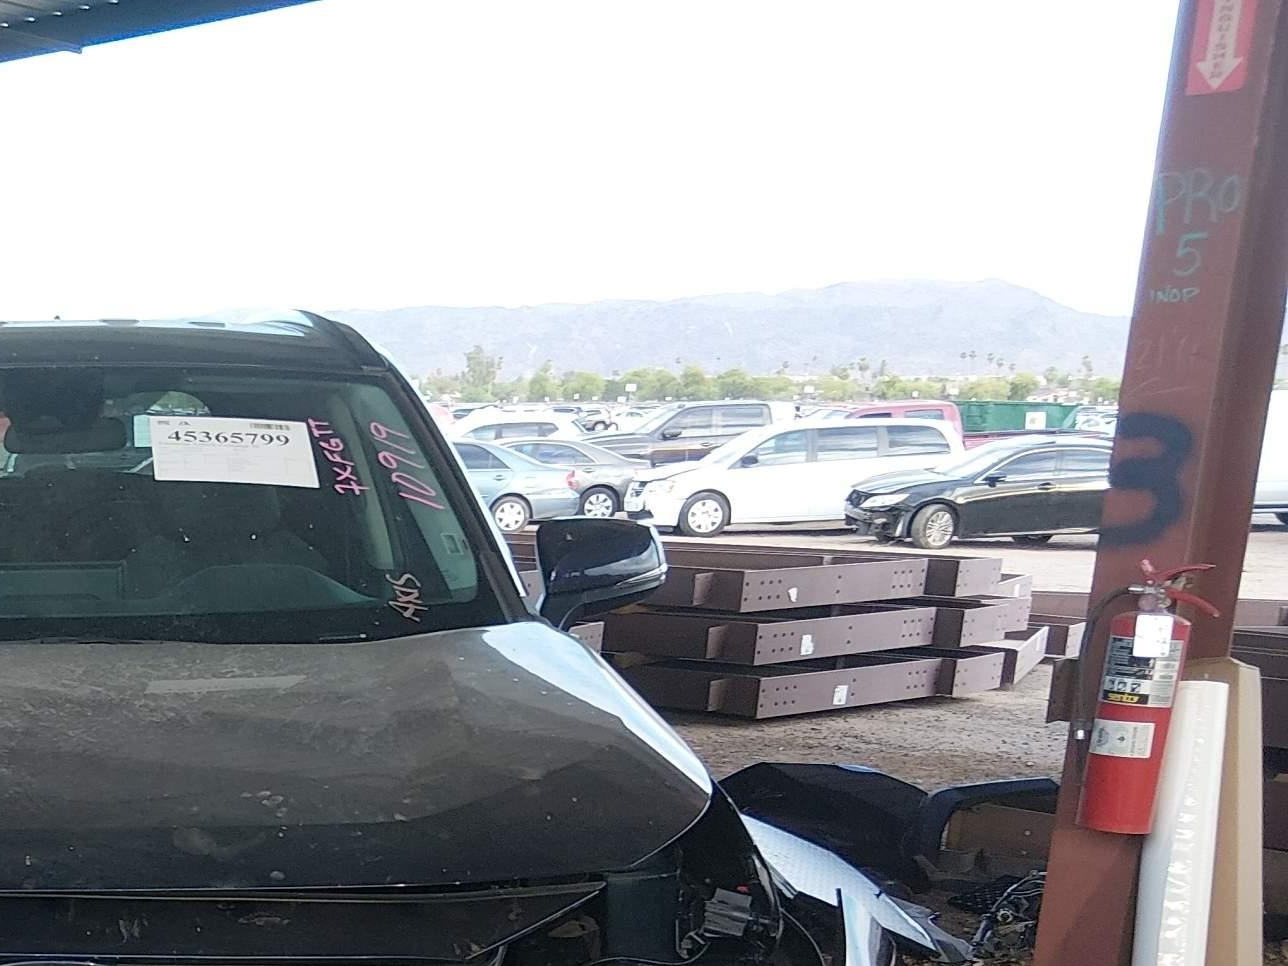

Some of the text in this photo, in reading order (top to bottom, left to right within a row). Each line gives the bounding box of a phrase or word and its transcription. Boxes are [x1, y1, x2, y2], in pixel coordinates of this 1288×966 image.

[1174, 231, 1209, 277] 5
[167, 430, 290, 447] 45365799
[369, 421, 445, 510] 10919
[1099, 412, 1193, 546] 3
